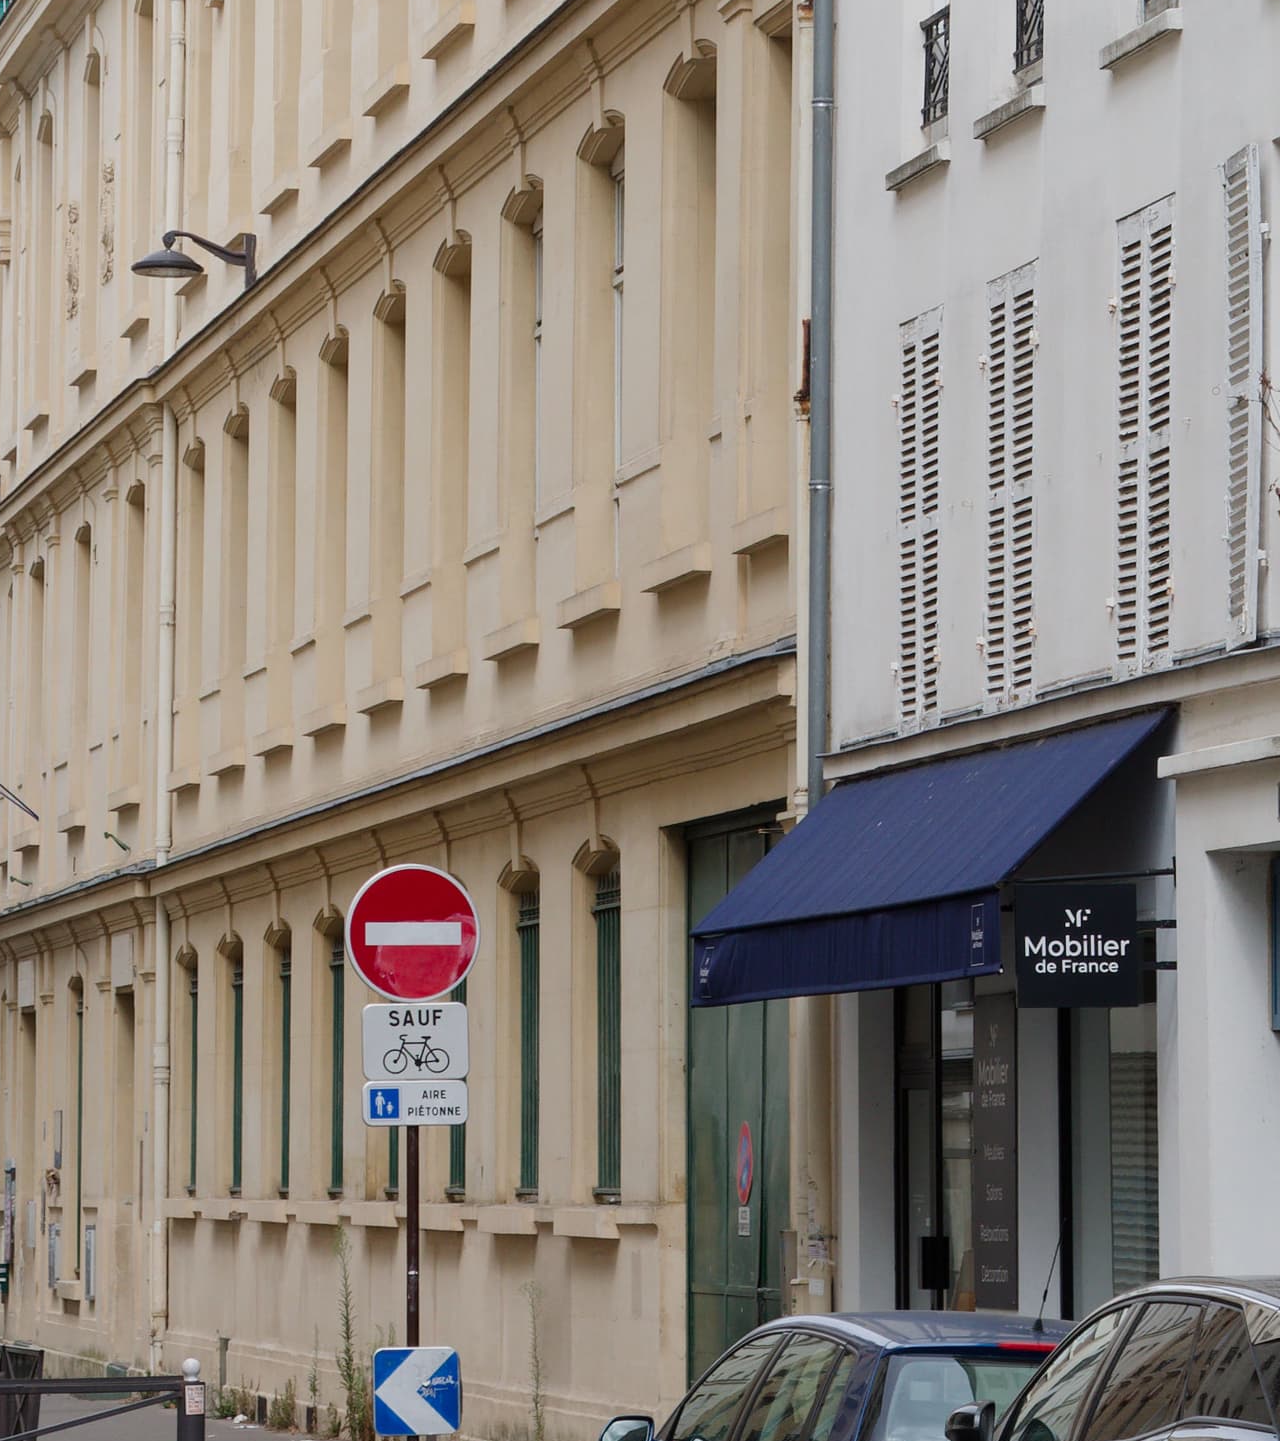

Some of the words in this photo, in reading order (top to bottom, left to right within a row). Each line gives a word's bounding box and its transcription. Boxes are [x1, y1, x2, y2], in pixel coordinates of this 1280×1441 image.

[1024, 934, 1130, 957] Mobilier
[1035, 959, 1057, 973] de
[1061, 960, 1119, 973] France
[389, 1009, 443, 1027] SAUF
[422, 1090, 447, 1099] AIRE
[407, 1106, 461, 1117] PIÉTONNE
